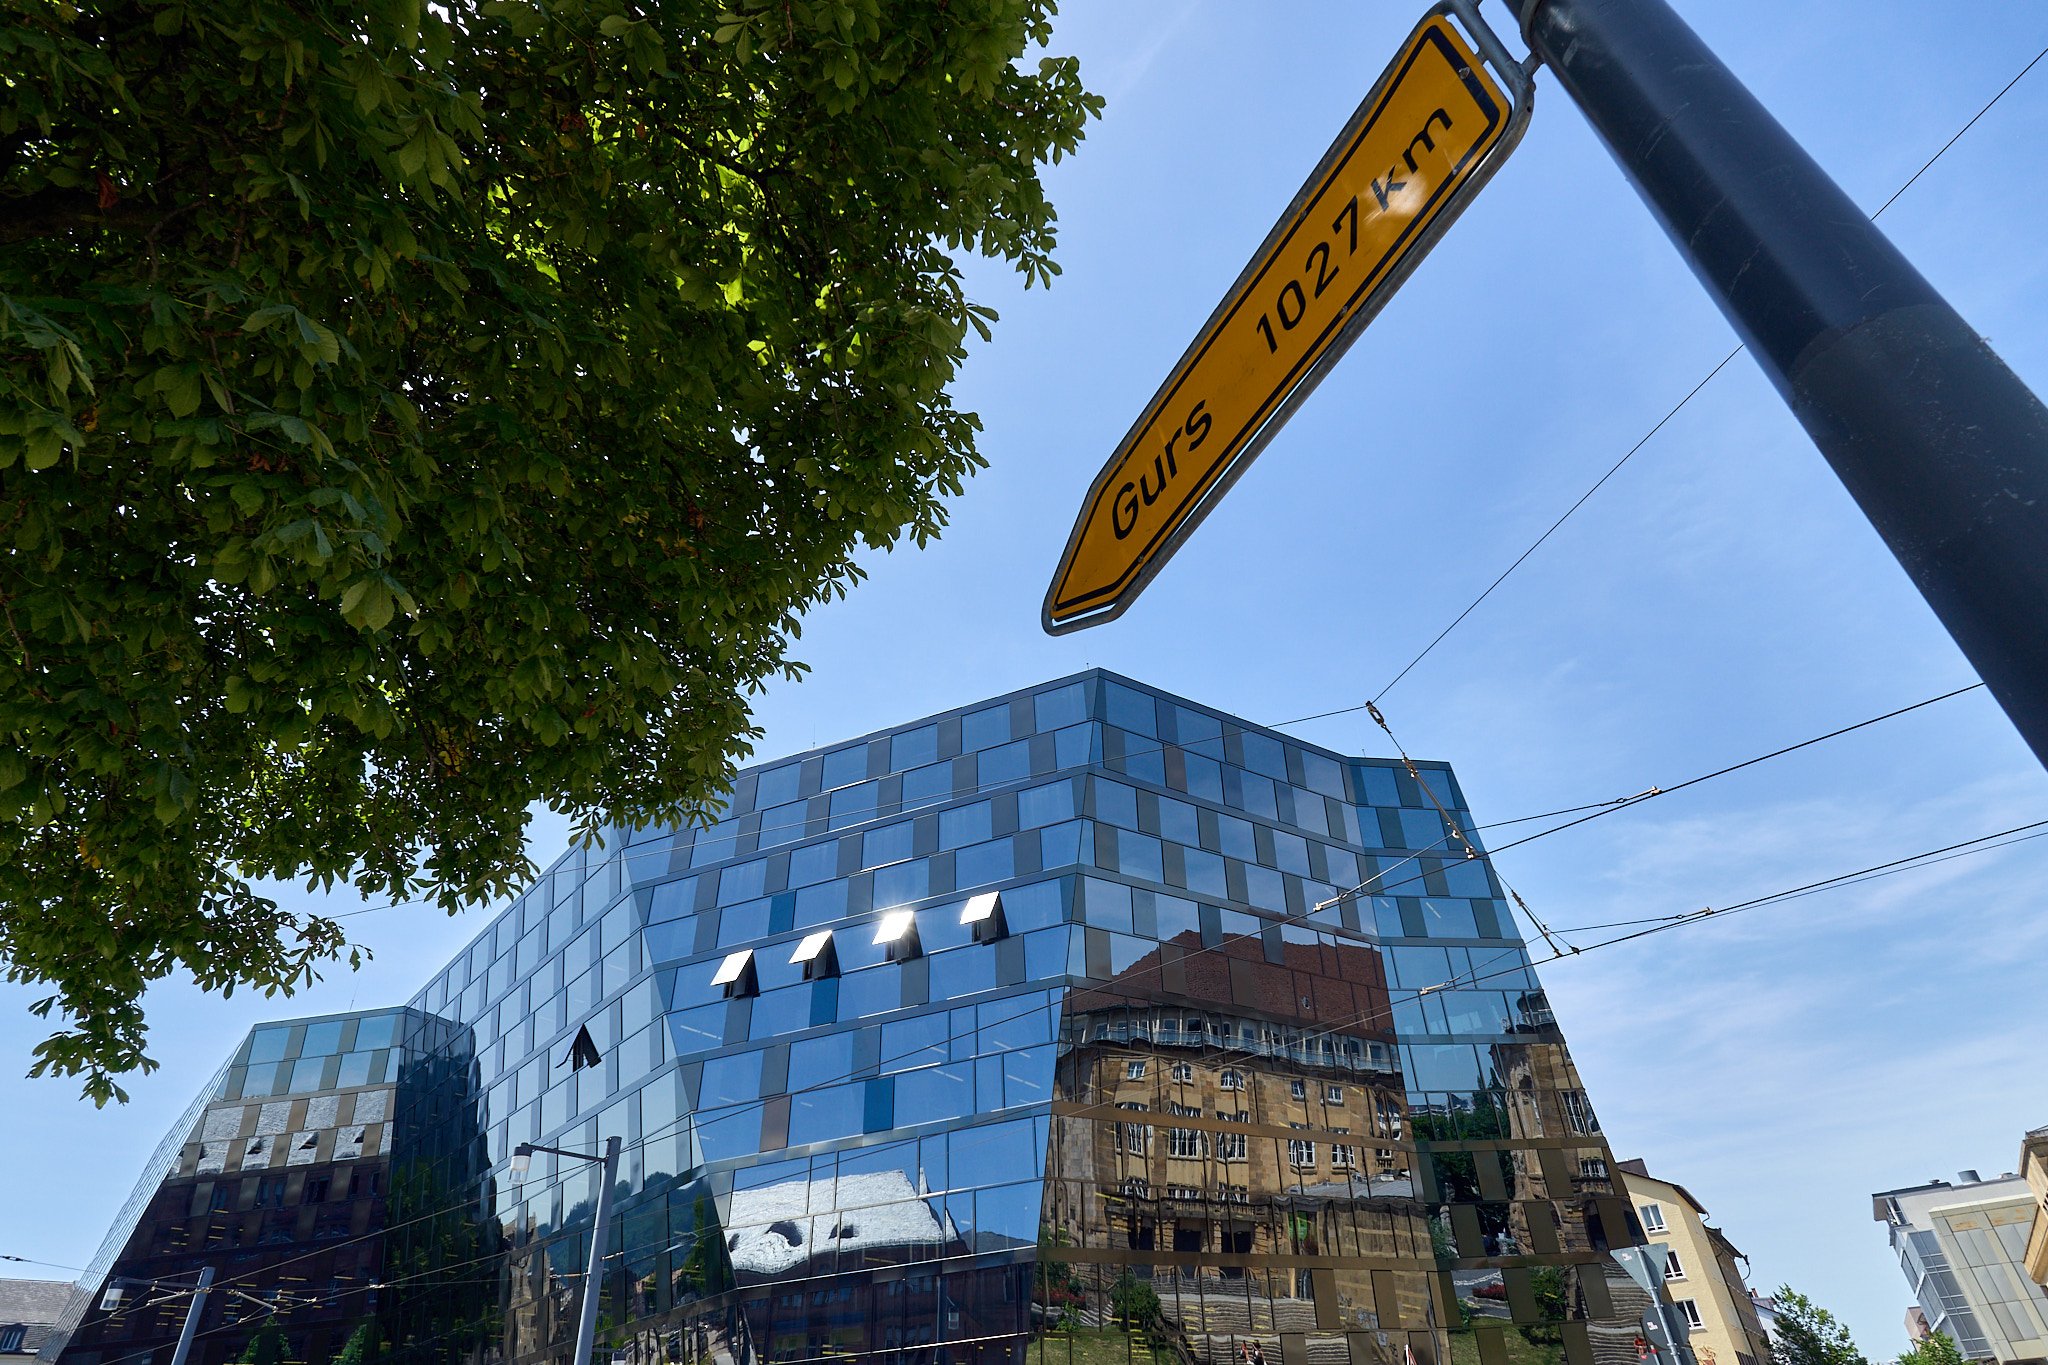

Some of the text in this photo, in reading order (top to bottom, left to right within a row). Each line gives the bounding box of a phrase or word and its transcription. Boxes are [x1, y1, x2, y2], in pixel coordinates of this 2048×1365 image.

[1111, 107, 1454, 540] Gurs 1027 km
